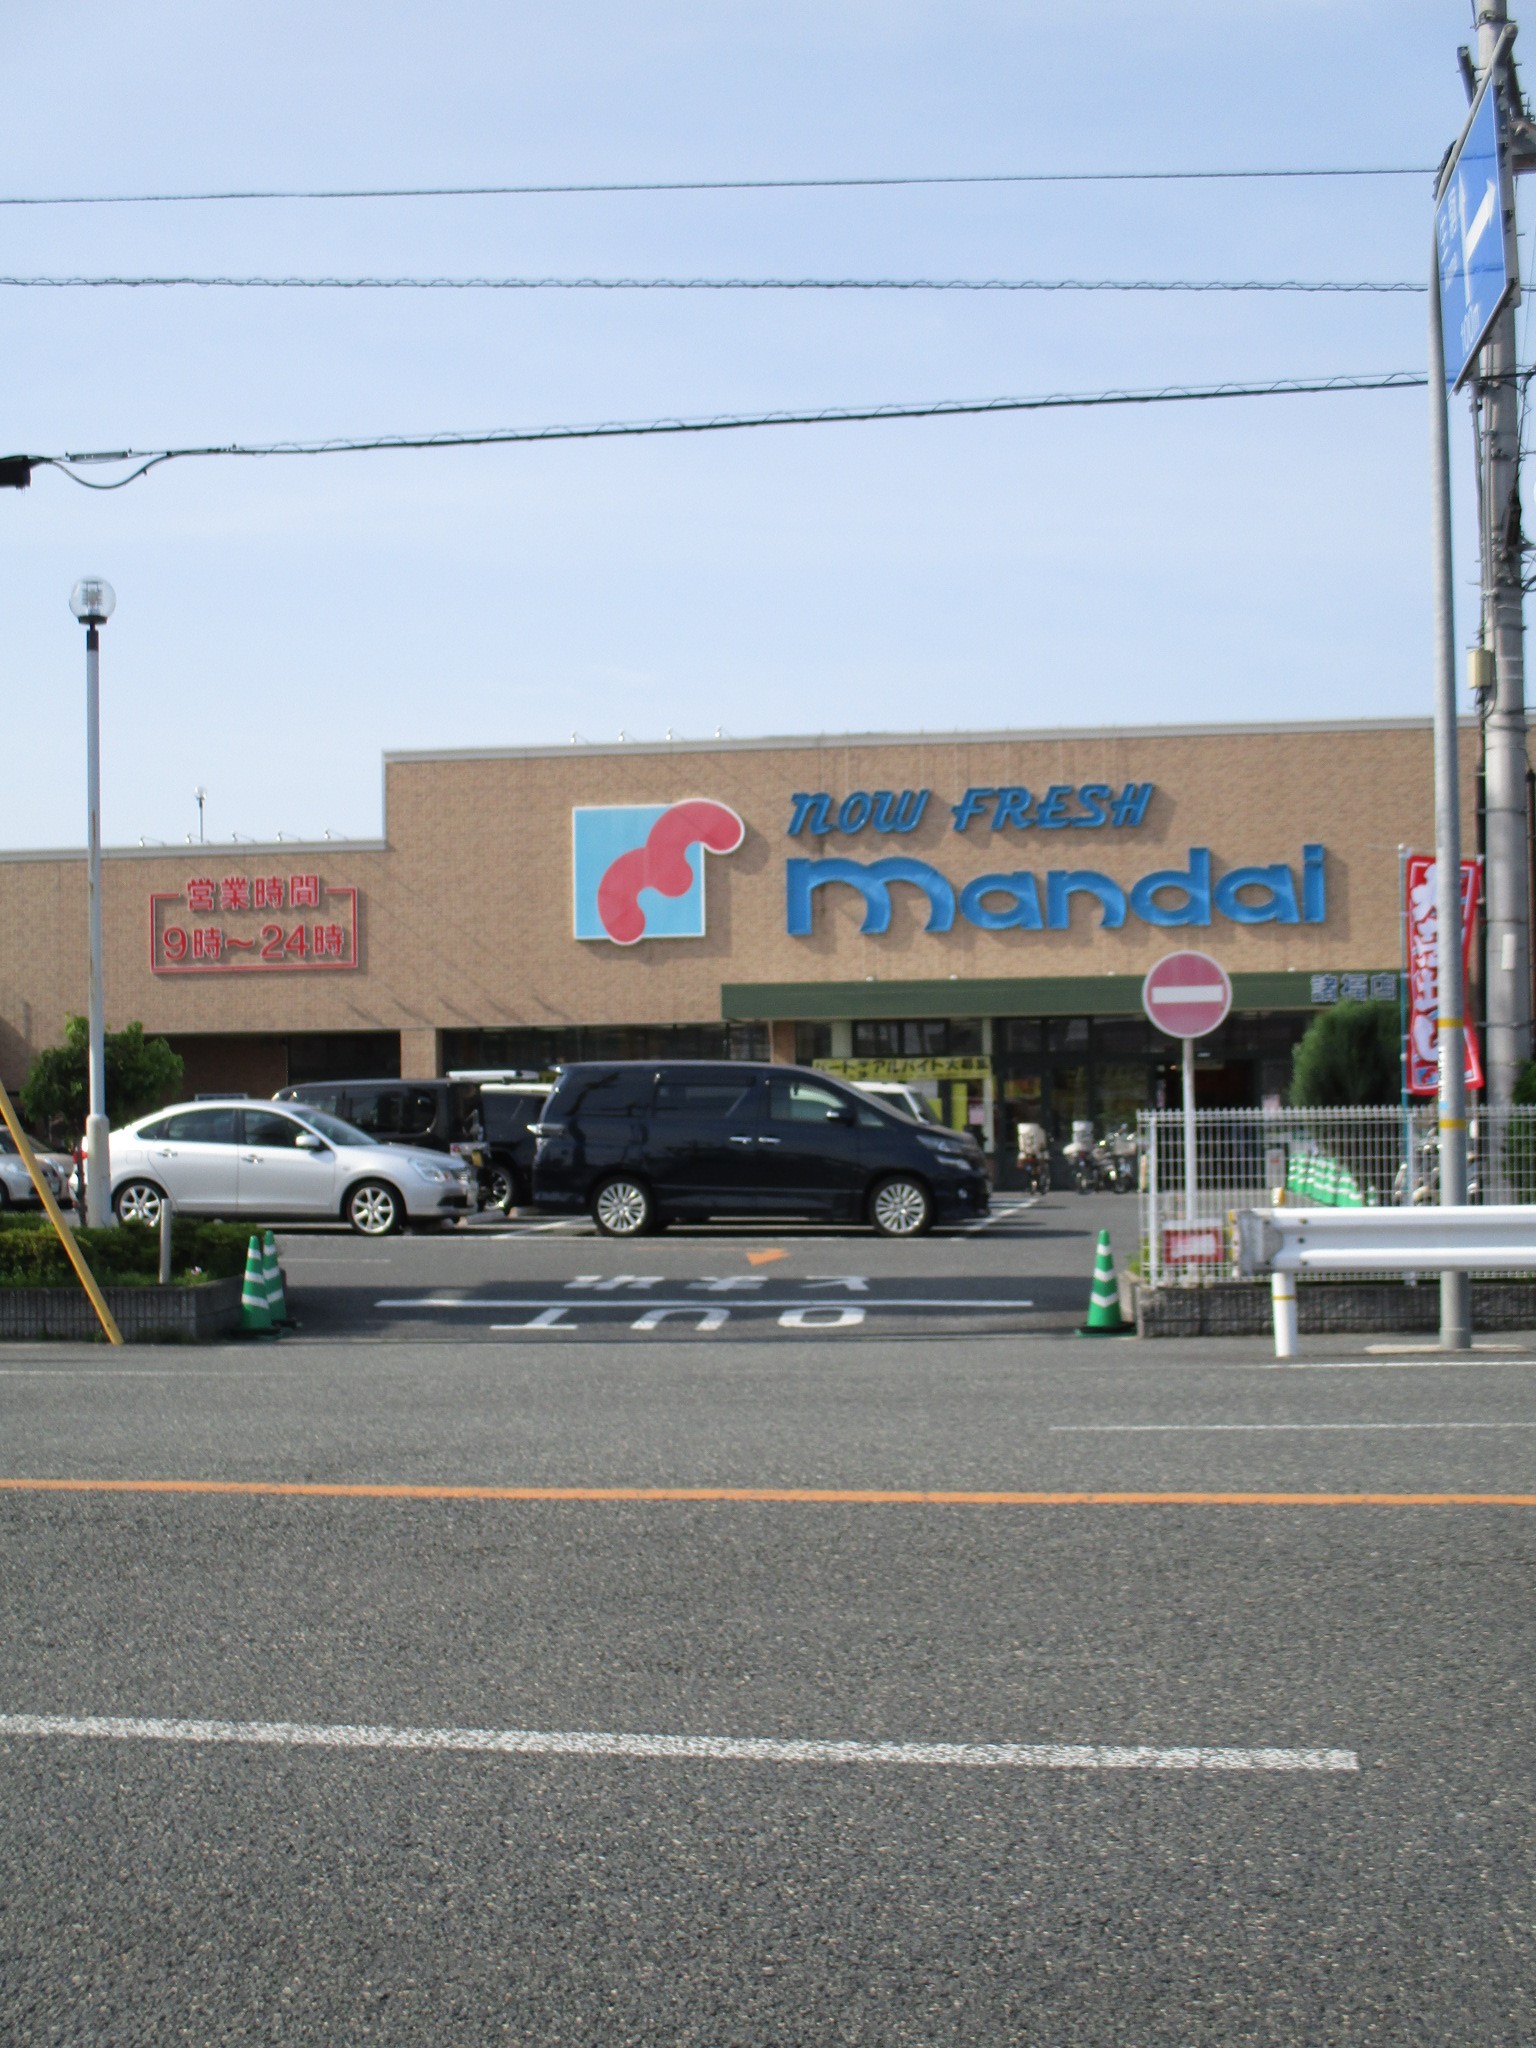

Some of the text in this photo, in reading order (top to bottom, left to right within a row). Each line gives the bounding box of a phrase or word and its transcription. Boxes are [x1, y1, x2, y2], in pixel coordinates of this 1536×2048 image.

[950, 783, 1154, 832] FRESH
[187, 873, 320, 911] 営業時間
[786, 843, 1327, 936] mandai
[489, 1306, 867, 1332] OUT
